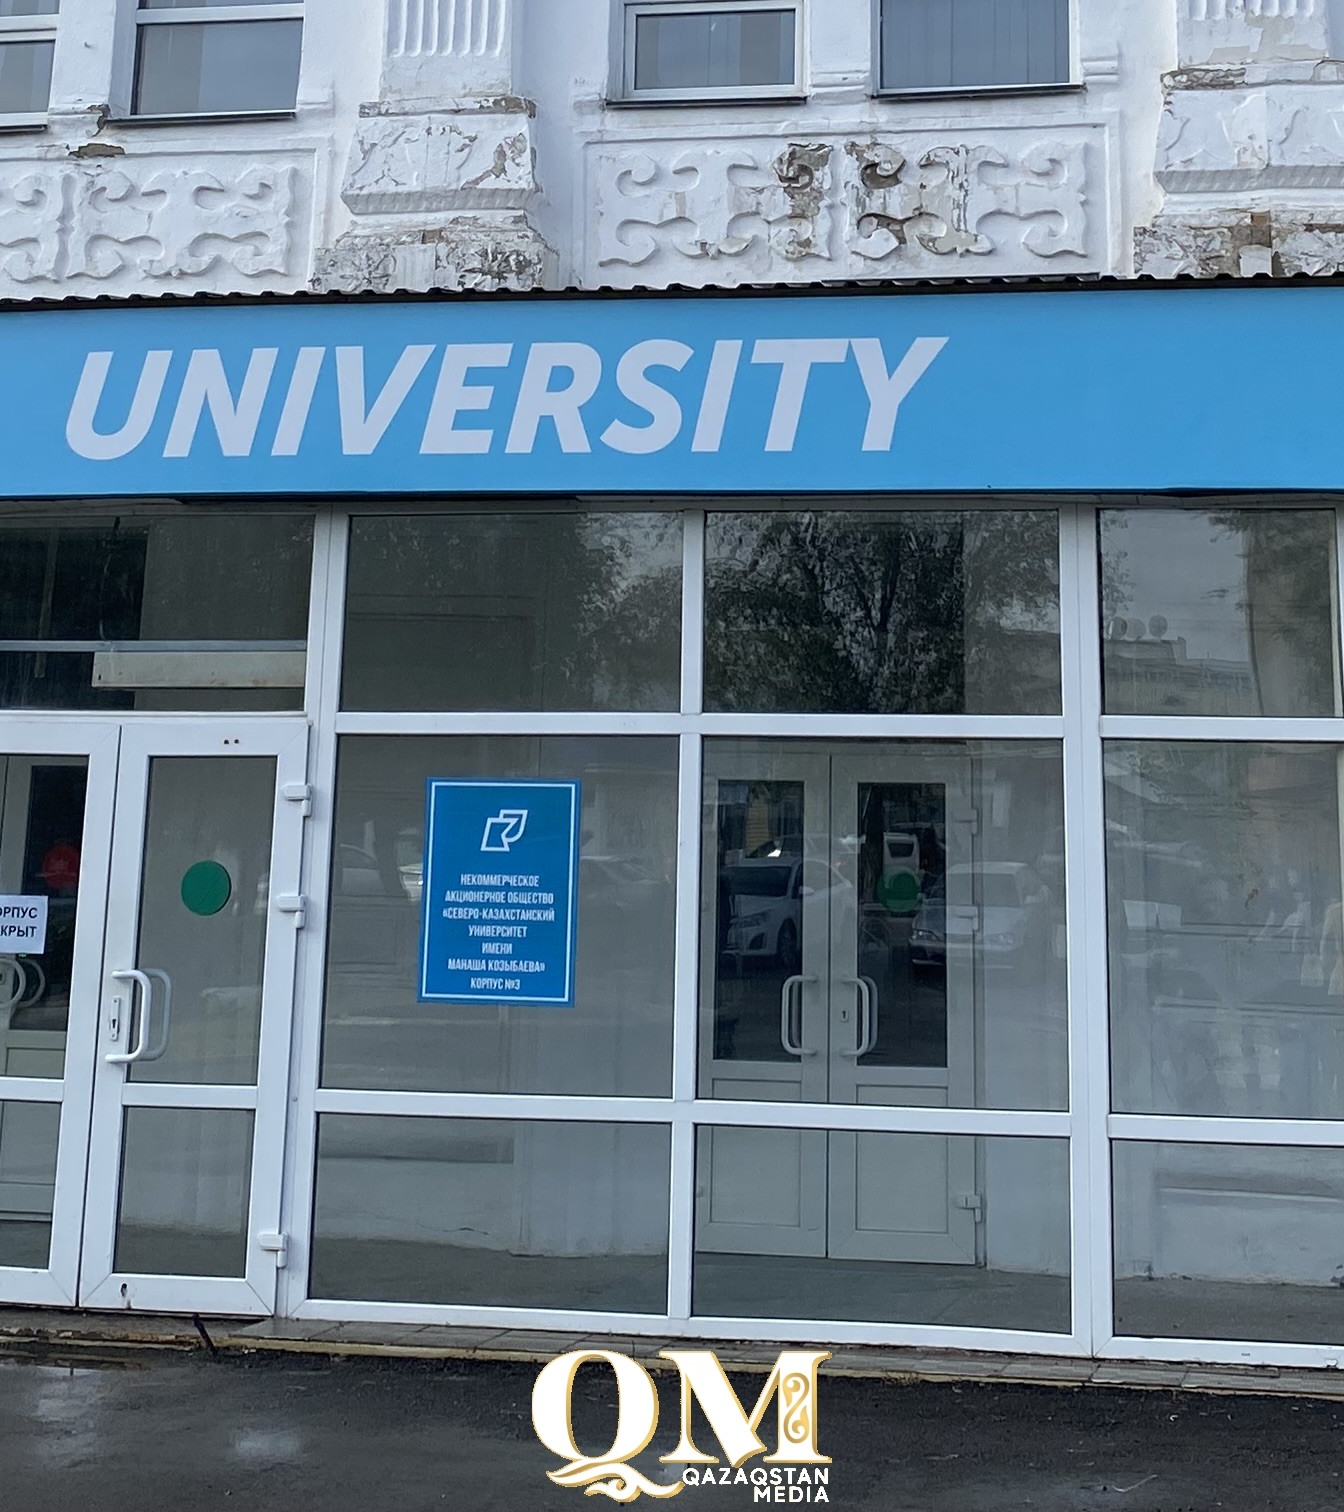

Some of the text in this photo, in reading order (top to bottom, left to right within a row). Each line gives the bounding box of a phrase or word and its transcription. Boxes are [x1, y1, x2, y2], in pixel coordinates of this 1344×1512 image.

[64, 335, 950, 462] UNIVERSITY
[460, 874, 540, 887] НЕКОММЕРЧЕСКОЕ
[445, 890, 554, 905] АКЦИОНЕРНОЕ ОБЩЕСТВО
[468, 925, 528, 938] УНИВЕРСИТЕТ
[481, 942, 512, 955] ИМЕНИ
[448, 958, 486, 971] МАНАША
[470, 977, 521, 990] КОРПУС №3
